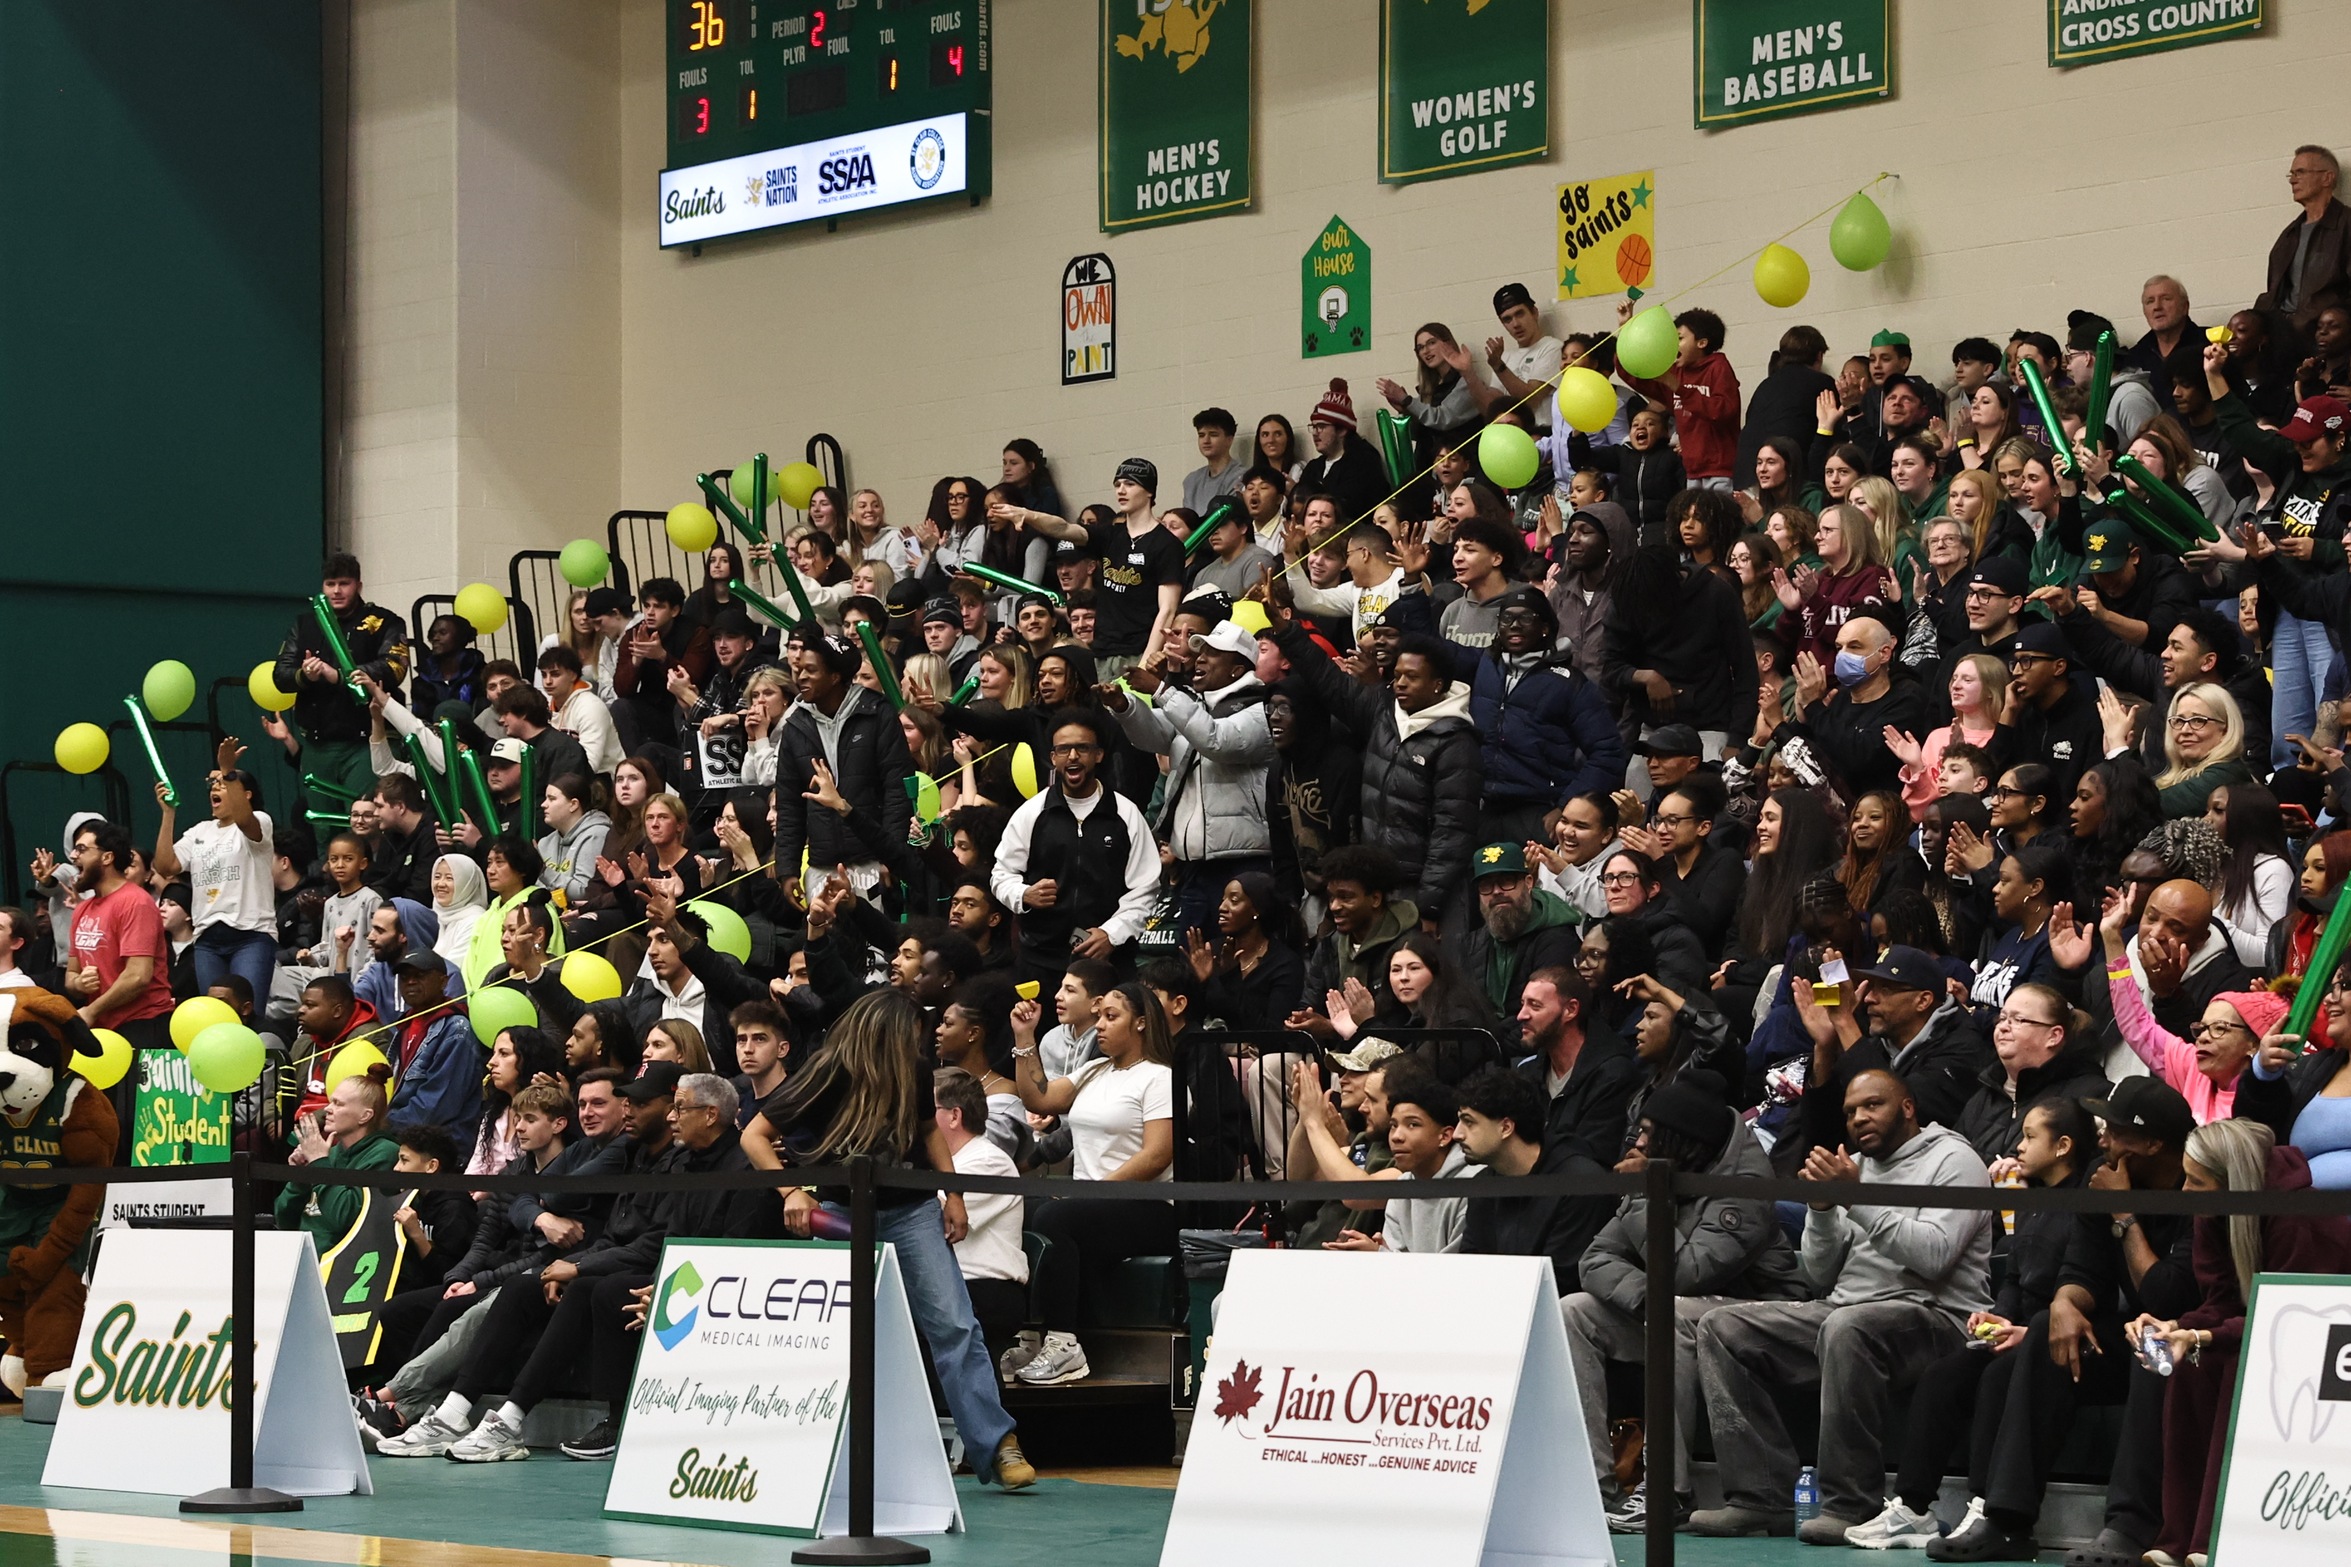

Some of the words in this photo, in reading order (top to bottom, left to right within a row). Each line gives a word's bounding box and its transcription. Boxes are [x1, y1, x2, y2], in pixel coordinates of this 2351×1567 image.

[690, 1, 723, 50] 36
[772, 16, 805, 39] PERIOD
[811, 11, 826, 46] 2
[879, 28, 895, 45] TOL
[930, 11, 961, 34] FOULS
[2062, 13, 2139, 47] CROSS
[2147, 0, 2256, 32] COUNTRY
[783, 45, 806, 66] PLYR
[827, 36, 850, 56] FOUL
[948, 45, 964, 76] 4
[1752, 21, 1843, 66] MEN'S
[679, 67, 707, 89] FOULS
[740, 60, 754, 76] TOL
[890, 59, 897, 90] 1
[1724, 52, 1873, 107] BASEBALL
[697, 98, 709, 133] 3
[749, 90, 756, 119] 1
[1411, 80, 1535, 129] WOMEN'S
[1440, 119, 1507, 158] GOLF
[818, 153, 877, 195] SSAA
[1147, 138, 1220, 177] MEN'S
[766, 165, 797, 188] SAINTS
[1136, 169, 1231, 211] HOCKEY
[665, 186, 726, 224] Saints
[766, 185, 797, 208] NATION
[1559, 183, 1589, 226] go
[1564, 190, 1631, 260] saints
[1075, 258, 1101, 284] WE
[1067, 284, 1110, 331] OWN
[1068, 342, 1110, 376] PAINT
[705, 737, 742, 777] SS
[151, 1096, 232, 1146] Student
[13, 1136, 61, 1156] CLAIR
[113, 1203, 150, 1221] SAINTS
[153, 1204, 205, 1218] STUDENT
[342, 1251, 380, 1304] 2
[74, 1300, 257, 1413] Saint
[700, 1331, 761, 1347] MEDICAL
[768, 1334, 830, 1350] IMAGING
[633, 1377, 690, 1416] Official
[685, 1382, 740, 1427] Imaging
[741, 1384, 793, 1420] Partner
[795, 1388, 817, 1426] of
[812, 1379, 839, 1423] the
[1264, 1366, 1336, 1434] Jain
[1344, 1369, 1493, 1432] Overseas
[1372, 1428, 1424, 1449] Services
[1426, 1432, 1452, 1451] Pvt.
[1454, 1434, 1482, 1453] Ltd.
[669, 1447, 758, 1503] Saints
[1261, 1448, 1308, 1464] ETHICAL
[1432, 1459, 1478, 1474] ADVICE
[2260, 1470, 2351, 1531] Offici
